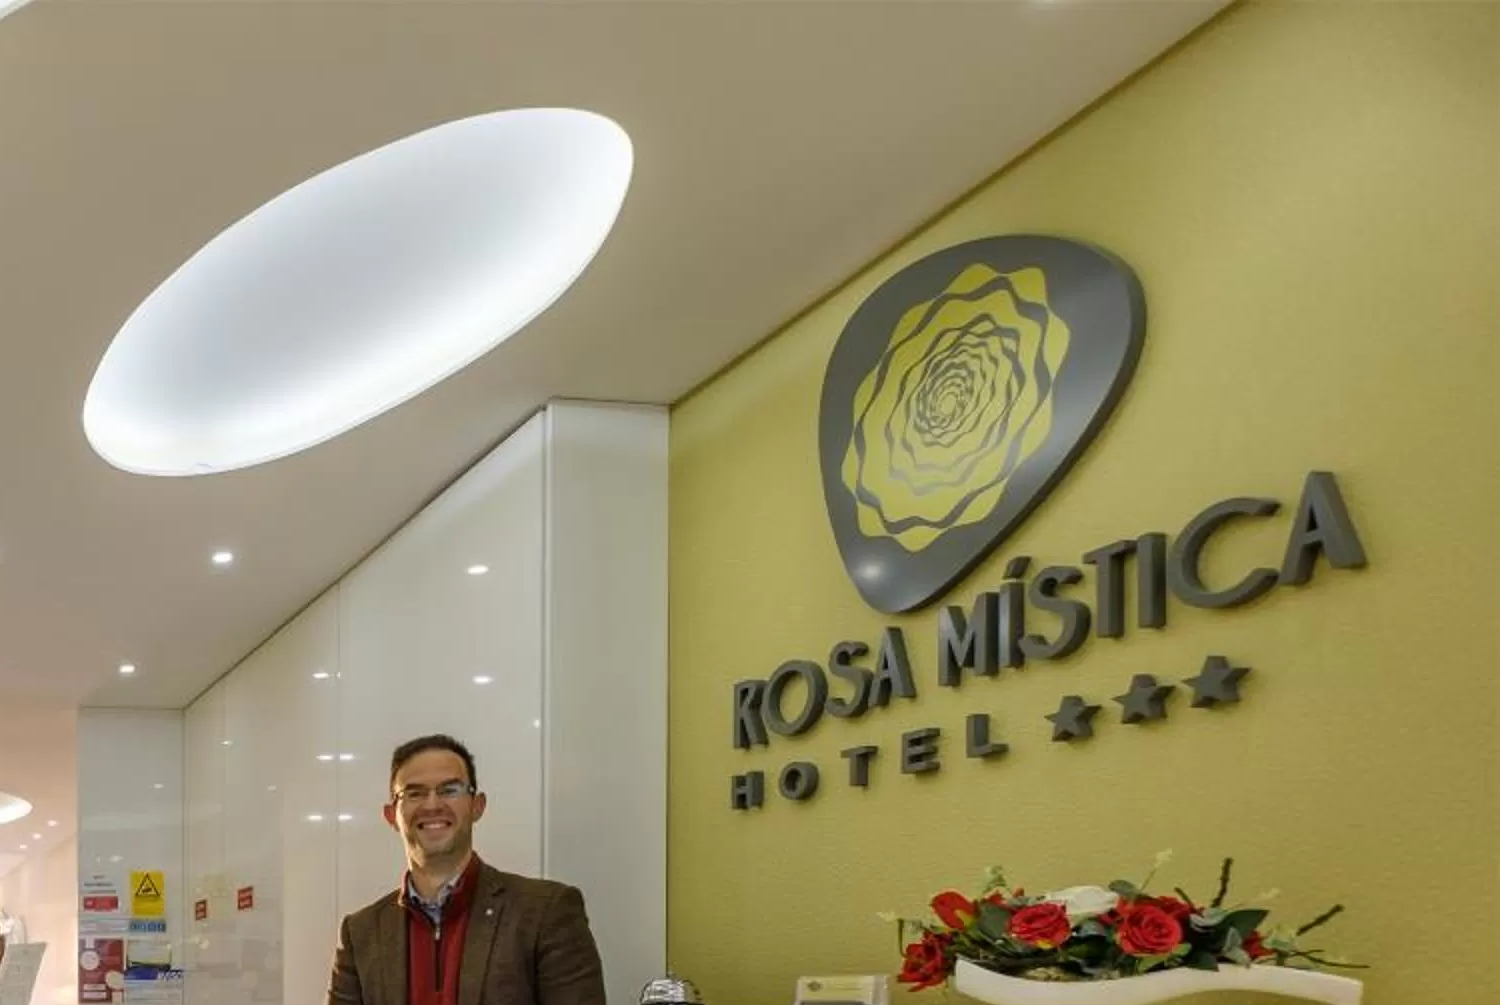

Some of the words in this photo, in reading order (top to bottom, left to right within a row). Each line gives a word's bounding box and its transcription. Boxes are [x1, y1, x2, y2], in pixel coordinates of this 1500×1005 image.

[733, 626, 916, 750] ROSA
[937, 470, 1368, 687] MÍSTICA
[731, 713, 1008, 810] HOTEL
